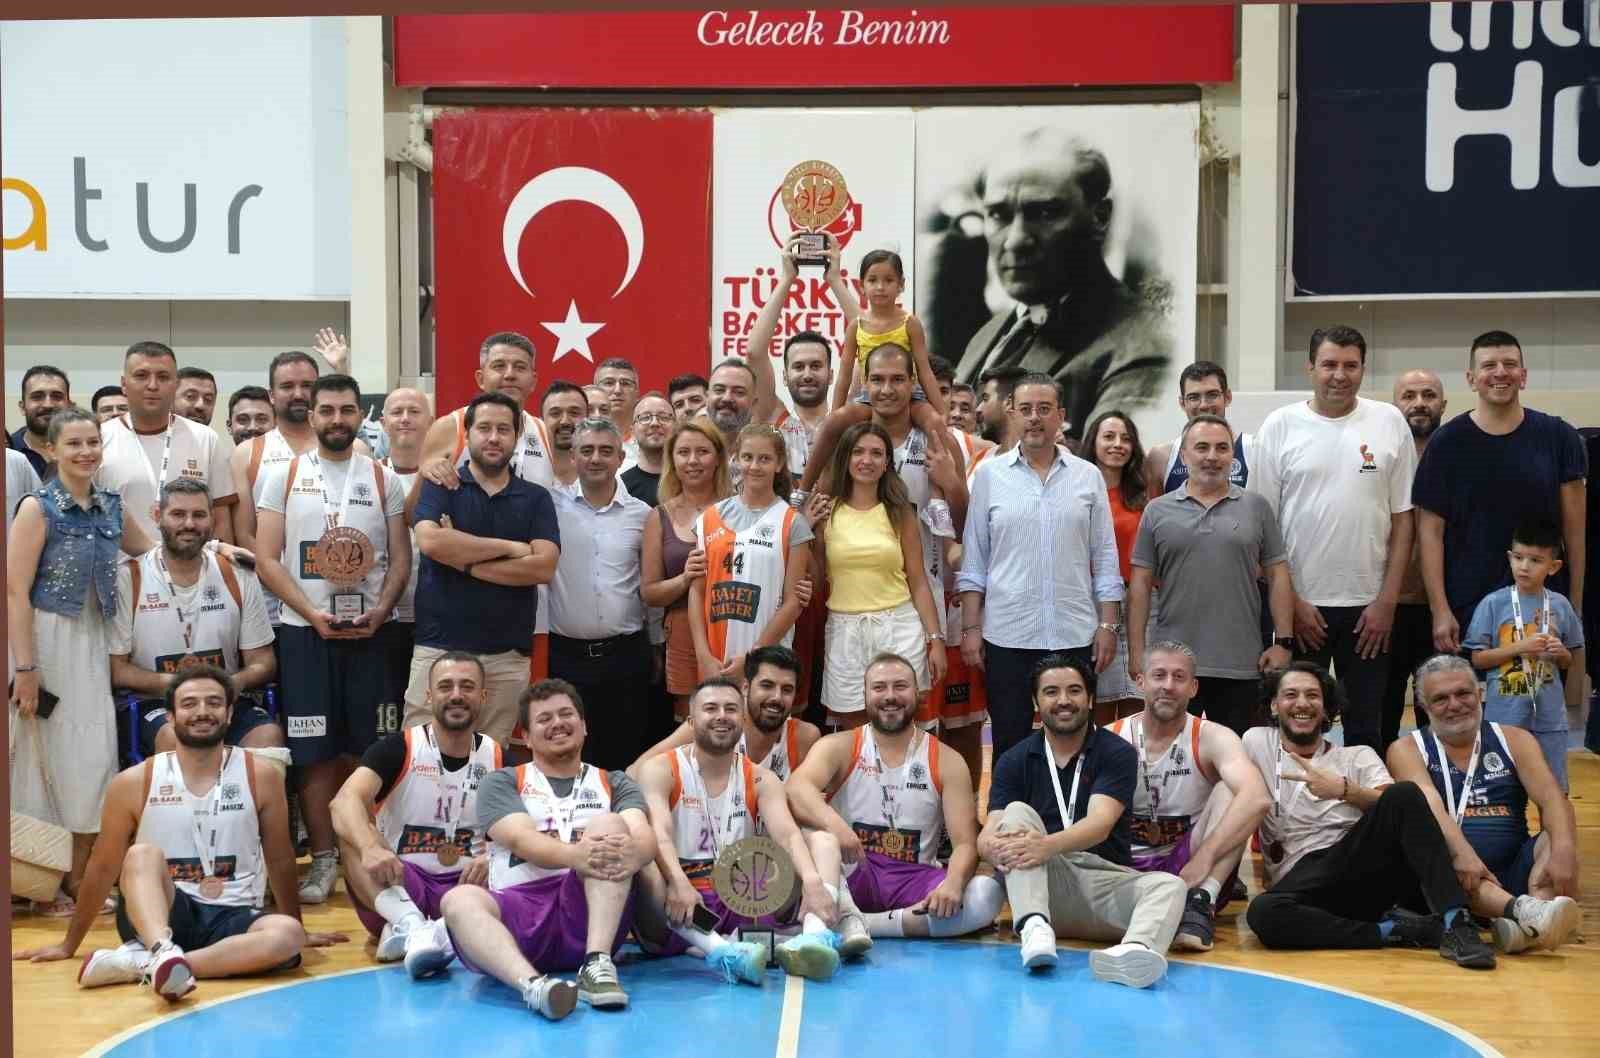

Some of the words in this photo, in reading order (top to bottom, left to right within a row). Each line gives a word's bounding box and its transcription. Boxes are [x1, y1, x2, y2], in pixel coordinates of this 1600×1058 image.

[697, 10, 824, 46] Gelecek
[834, 11, 950, 46] Benim
[723, 268, 903, 310] TÜRKY
